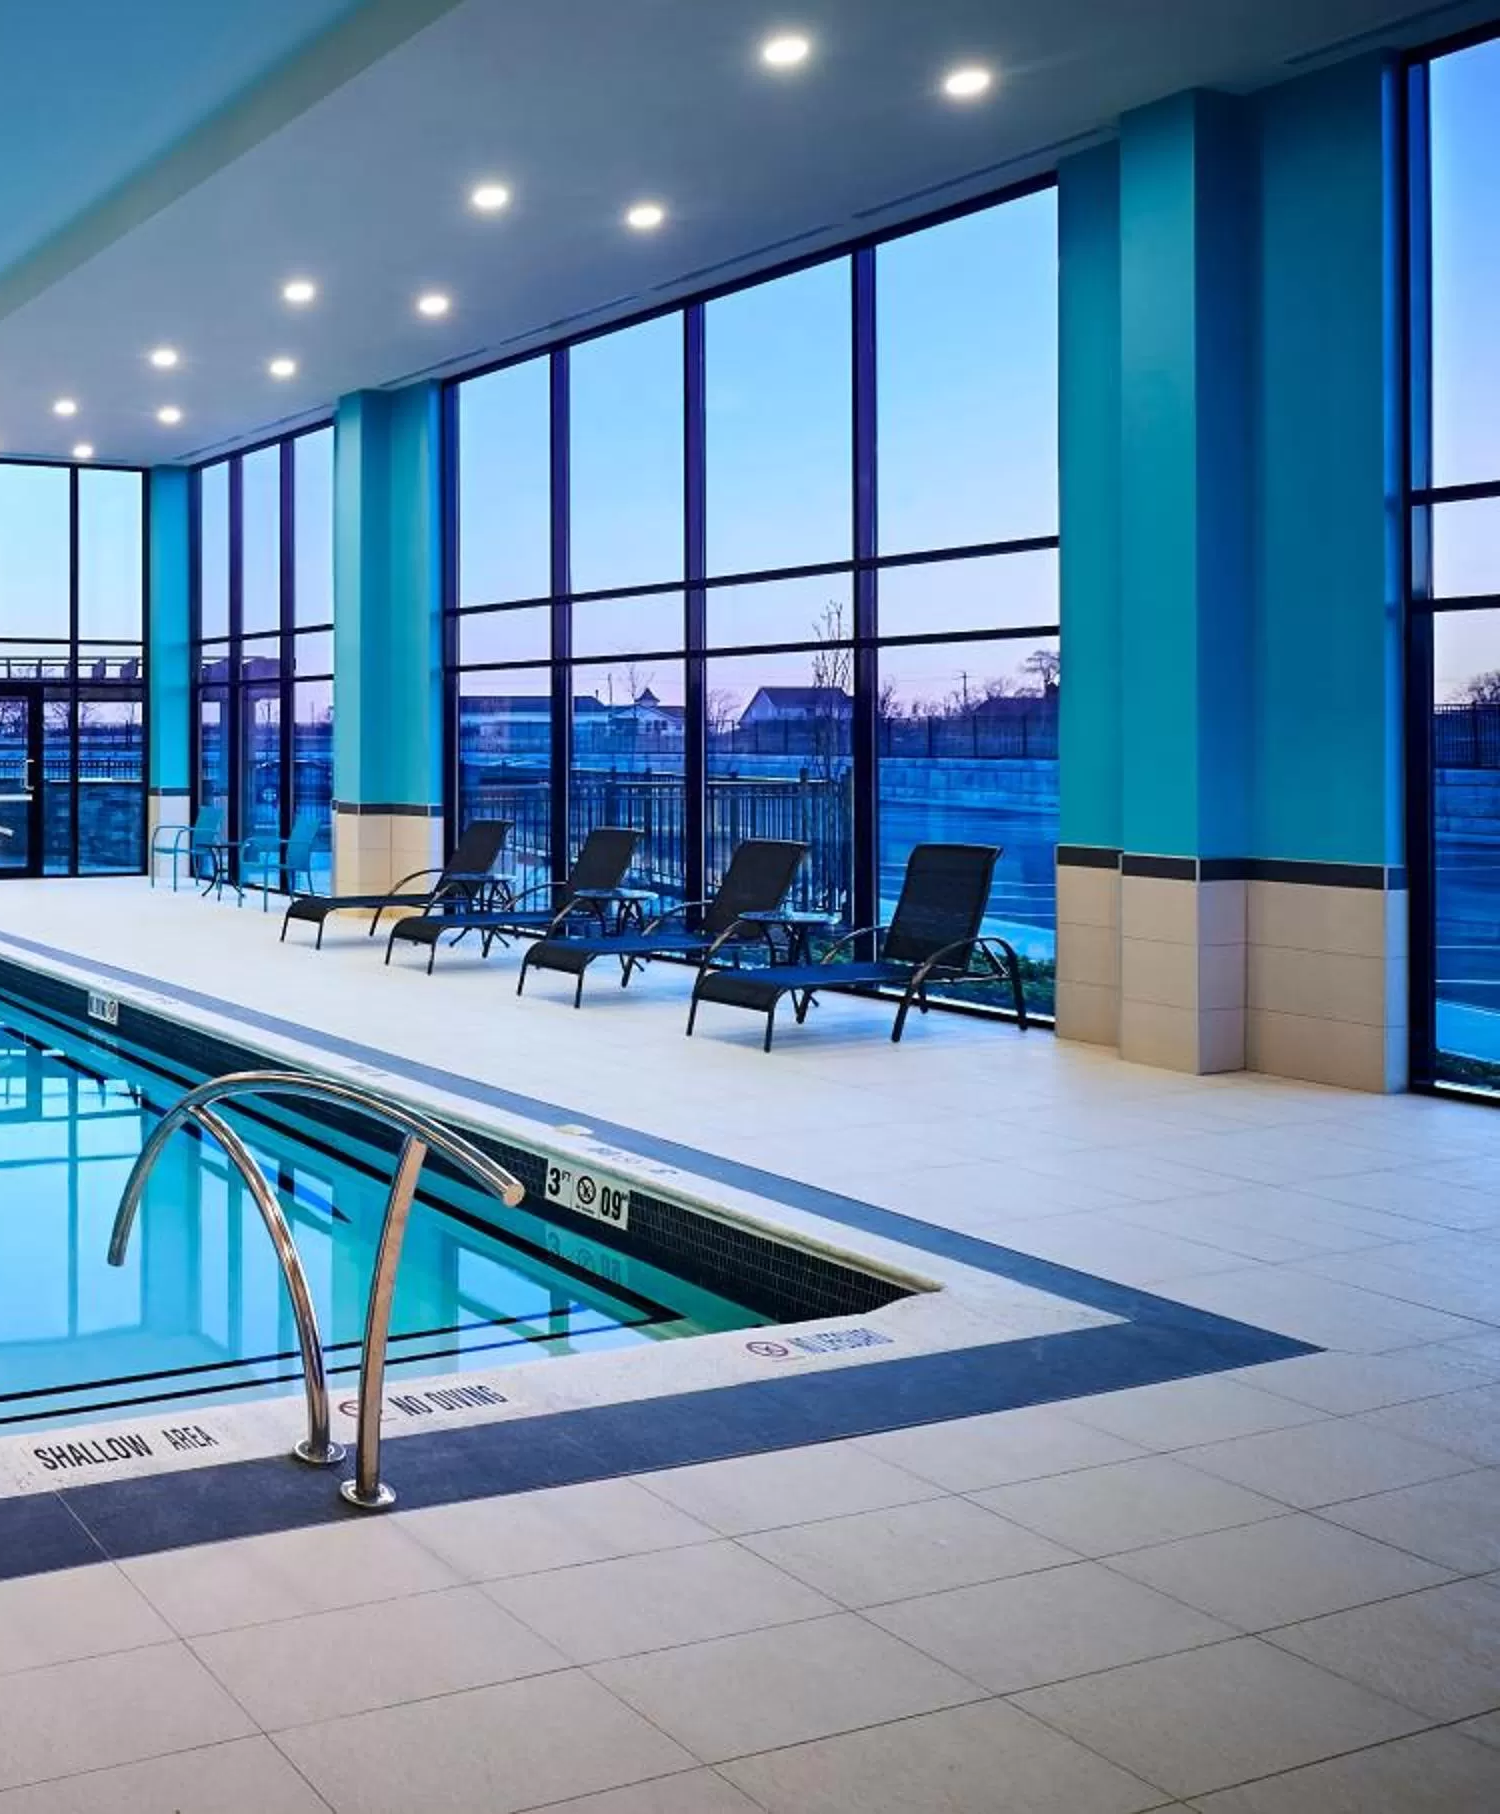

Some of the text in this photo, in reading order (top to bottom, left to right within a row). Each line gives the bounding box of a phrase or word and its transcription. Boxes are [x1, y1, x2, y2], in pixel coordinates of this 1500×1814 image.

[388, 1385, 508, 1416] NO DIVING
[33, 1425, 219, 1470] SHALLOW AREA
